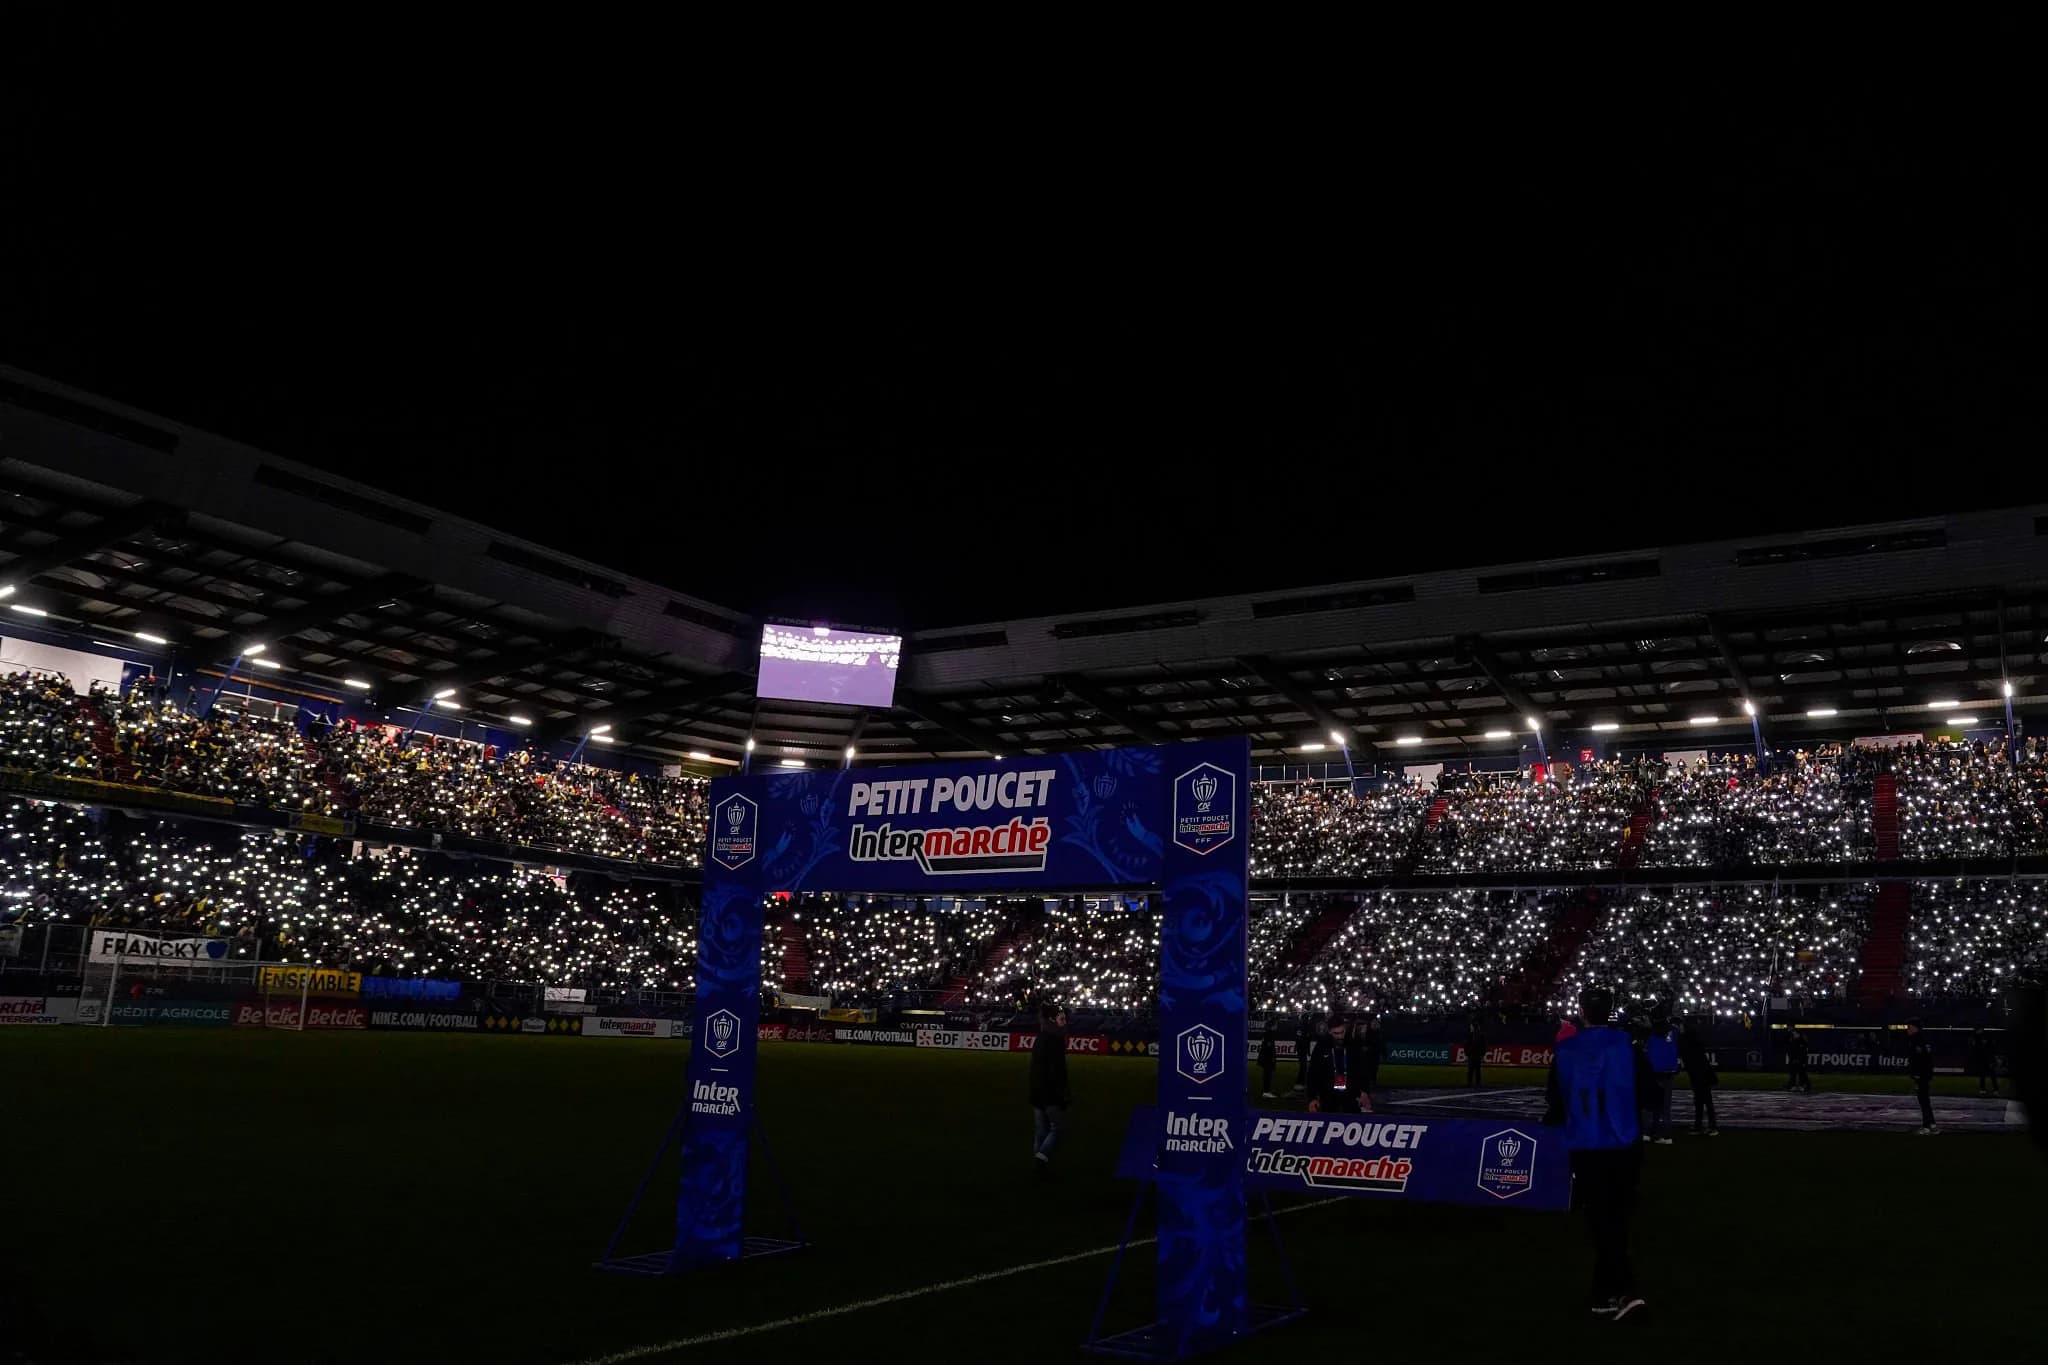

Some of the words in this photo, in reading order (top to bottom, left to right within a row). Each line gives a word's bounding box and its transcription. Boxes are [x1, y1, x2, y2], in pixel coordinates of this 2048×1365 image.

[848, 780, 929, 816] PETIT
[930, 770, 1056, 813] POUCET
[1180, 816, 1200, 824] PETIT
[1202, 814, 1229, 823] POUCET
[851, 817, 1051, 870] Intermarché
[102, 937, 202, 958] FRANCKY
[264, 970, 357, 992] ENSEMBLE
[160, 1007, 231, 1020] AGRICOLE
[308, 1008, 364, 1026] Betclic
[371, 1010, 478, 1029] NIKE.COM/FOOTBALL
[834, 1028, 914, 1043] NIKE.COM/FOOTBALL
[1067, 1037, 1099, 1051] KFC
[1391, 1050, 1449, 1060] AGRICOLE
[1821, 1053, 1871, 1067] POUCET
[693, 1080, 741, 1108] Inter
[692, 1102, 736, 1116] marché
[1166, 1112, 1234, 1145] Inter
[1252, 1118, 1324, 1144] PETIT
[1323, 1122, 1428, 1149] POUCET
[1166, 1138, 1226, 1153] marché
[1248, 1149, 1412, 1186] Intermarché
